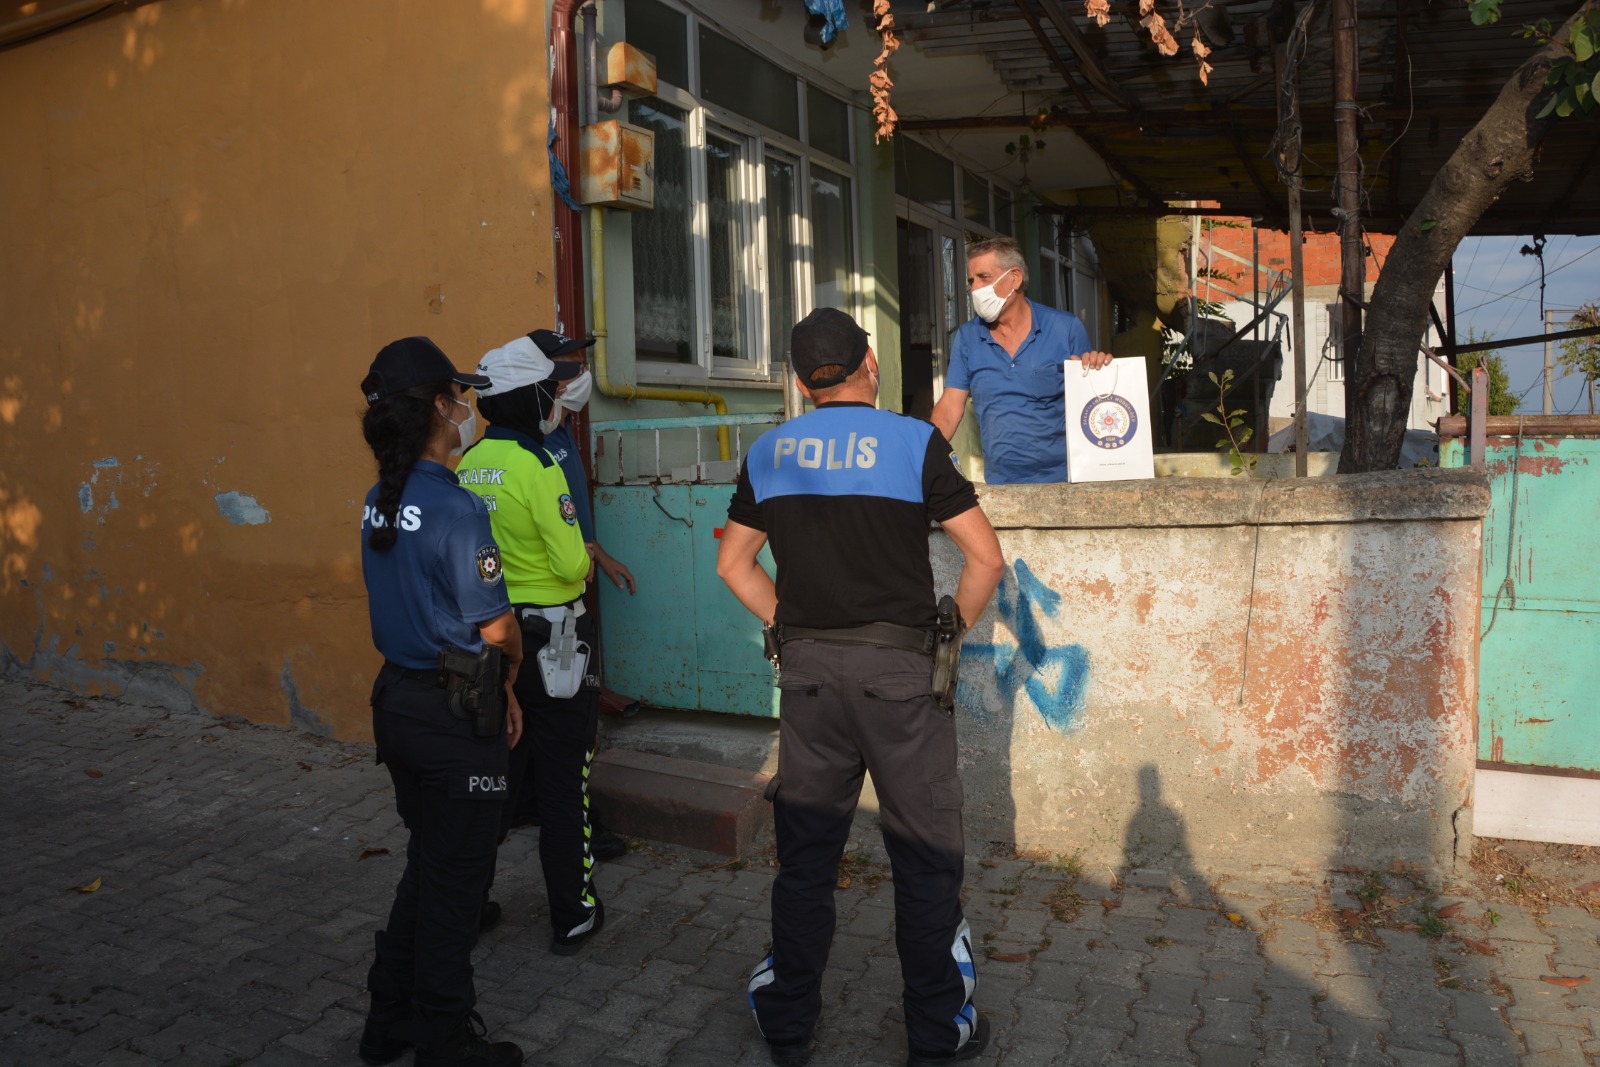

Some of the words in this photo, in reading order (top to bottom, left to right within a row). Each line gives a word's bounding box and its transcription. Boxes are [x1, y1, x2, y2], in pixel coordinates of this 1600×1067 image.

[774, 432, 878, 470] POLİS
[457, 469, 505, 485] RAFİK
[361, 504, 421, 531] POİS
[469, 776, 507, 792] POLİS
